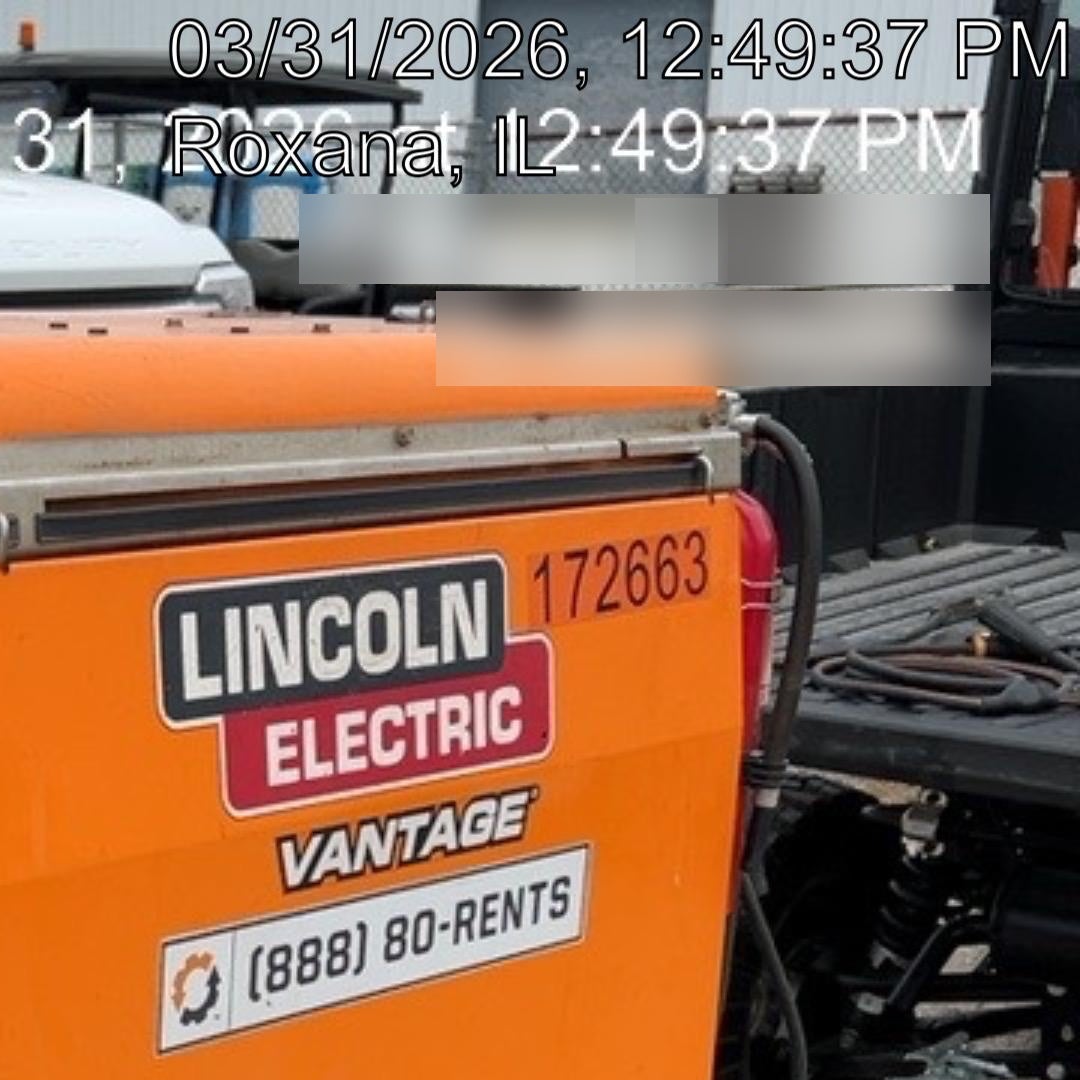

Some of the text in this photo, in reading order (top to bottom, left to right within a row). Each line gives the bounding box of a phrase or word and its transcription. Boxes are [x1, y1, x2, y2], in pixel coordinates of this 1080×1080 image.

[532, 530, 708, 623] 172663
[179, 578, 490, 702] LINCOLN
[265, 686, 523, 788] ELECTRIC
[278, 788, 528, 893] VANTAGE
[247, 876, 571, 1002] (888) 80-RENTS
